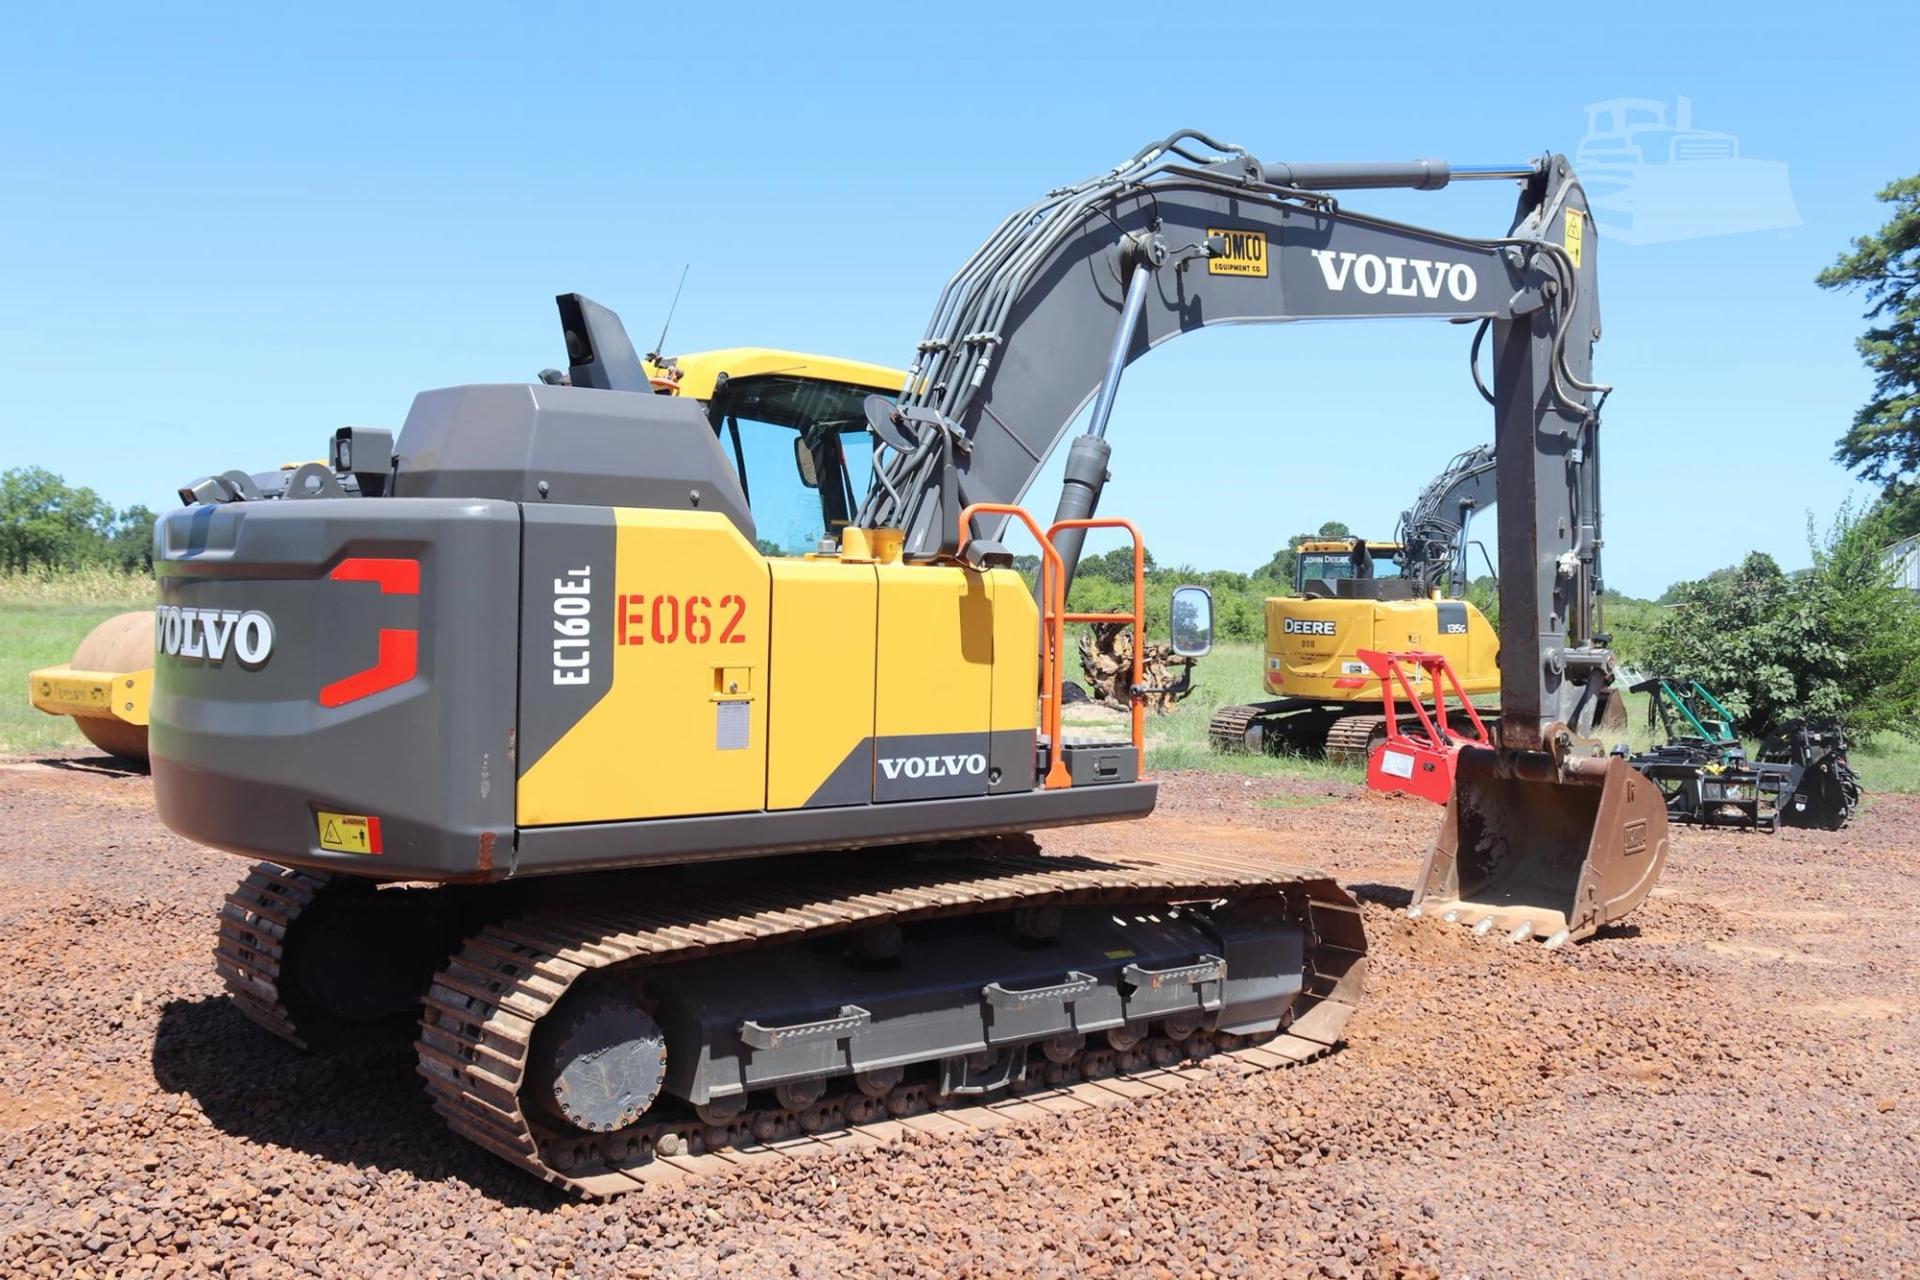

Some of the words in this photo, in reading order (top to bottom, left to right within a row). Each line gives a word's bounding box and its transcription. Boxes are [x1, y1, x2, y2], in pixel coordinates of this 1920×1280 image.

[1213, 232, 1262, 261] OMCO
[1214, 263, 1250, 272] EQUIPMENT
[1311, 249, 1477, 302] VOLVO
[1304, 556, 1323, 564] JOHN
[1324, 555, 1350, 564] DEERE
[618, 595, 746, 645] E062
[1284, 618, 1336, 635] DEERE
[156, 605, 276, 664] VOLVO
[878, 754, 987, 779] VOLVO
